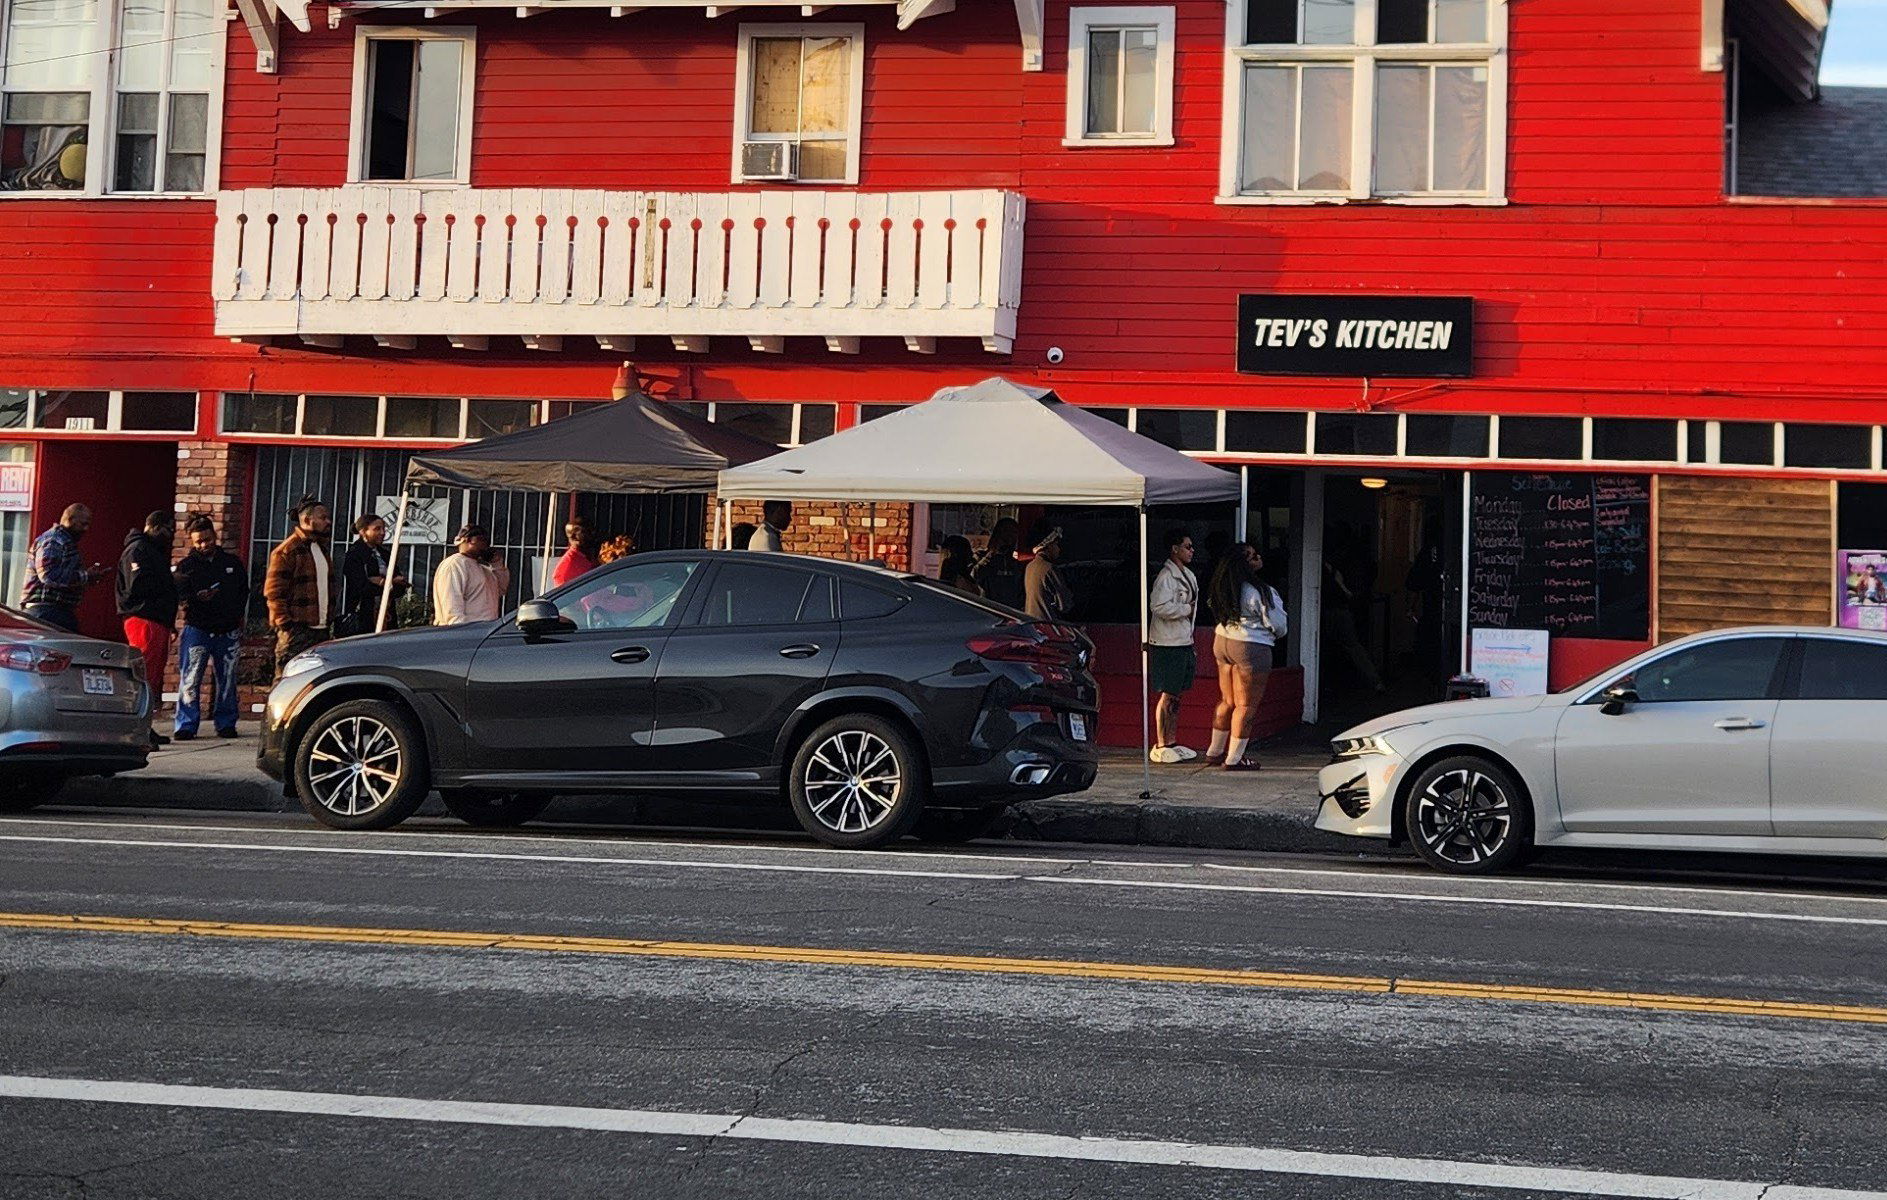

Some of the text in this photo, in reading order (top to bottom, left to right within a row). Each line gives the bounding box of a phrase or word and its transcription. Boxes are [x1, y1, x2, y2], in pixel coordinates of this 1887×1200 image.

[1255, 318, 1453, 350] TEV'S KITCHEN
[67, 418, 91, 431] 1911
[1, 467, 31, 493] RENT
[1474, 494, 1591, 518] Monday Closed
[1476, 517, 1519, 537] Tuesday
[1474, 533, 1525, 558] Wednesday
[1472, 551, 1520, 575] Thursday
[1474, 568, 1512, 589] Friday
[1470, 586, 1520, 616] Saturday
[1469, 605, 1509, 627] Sunday
